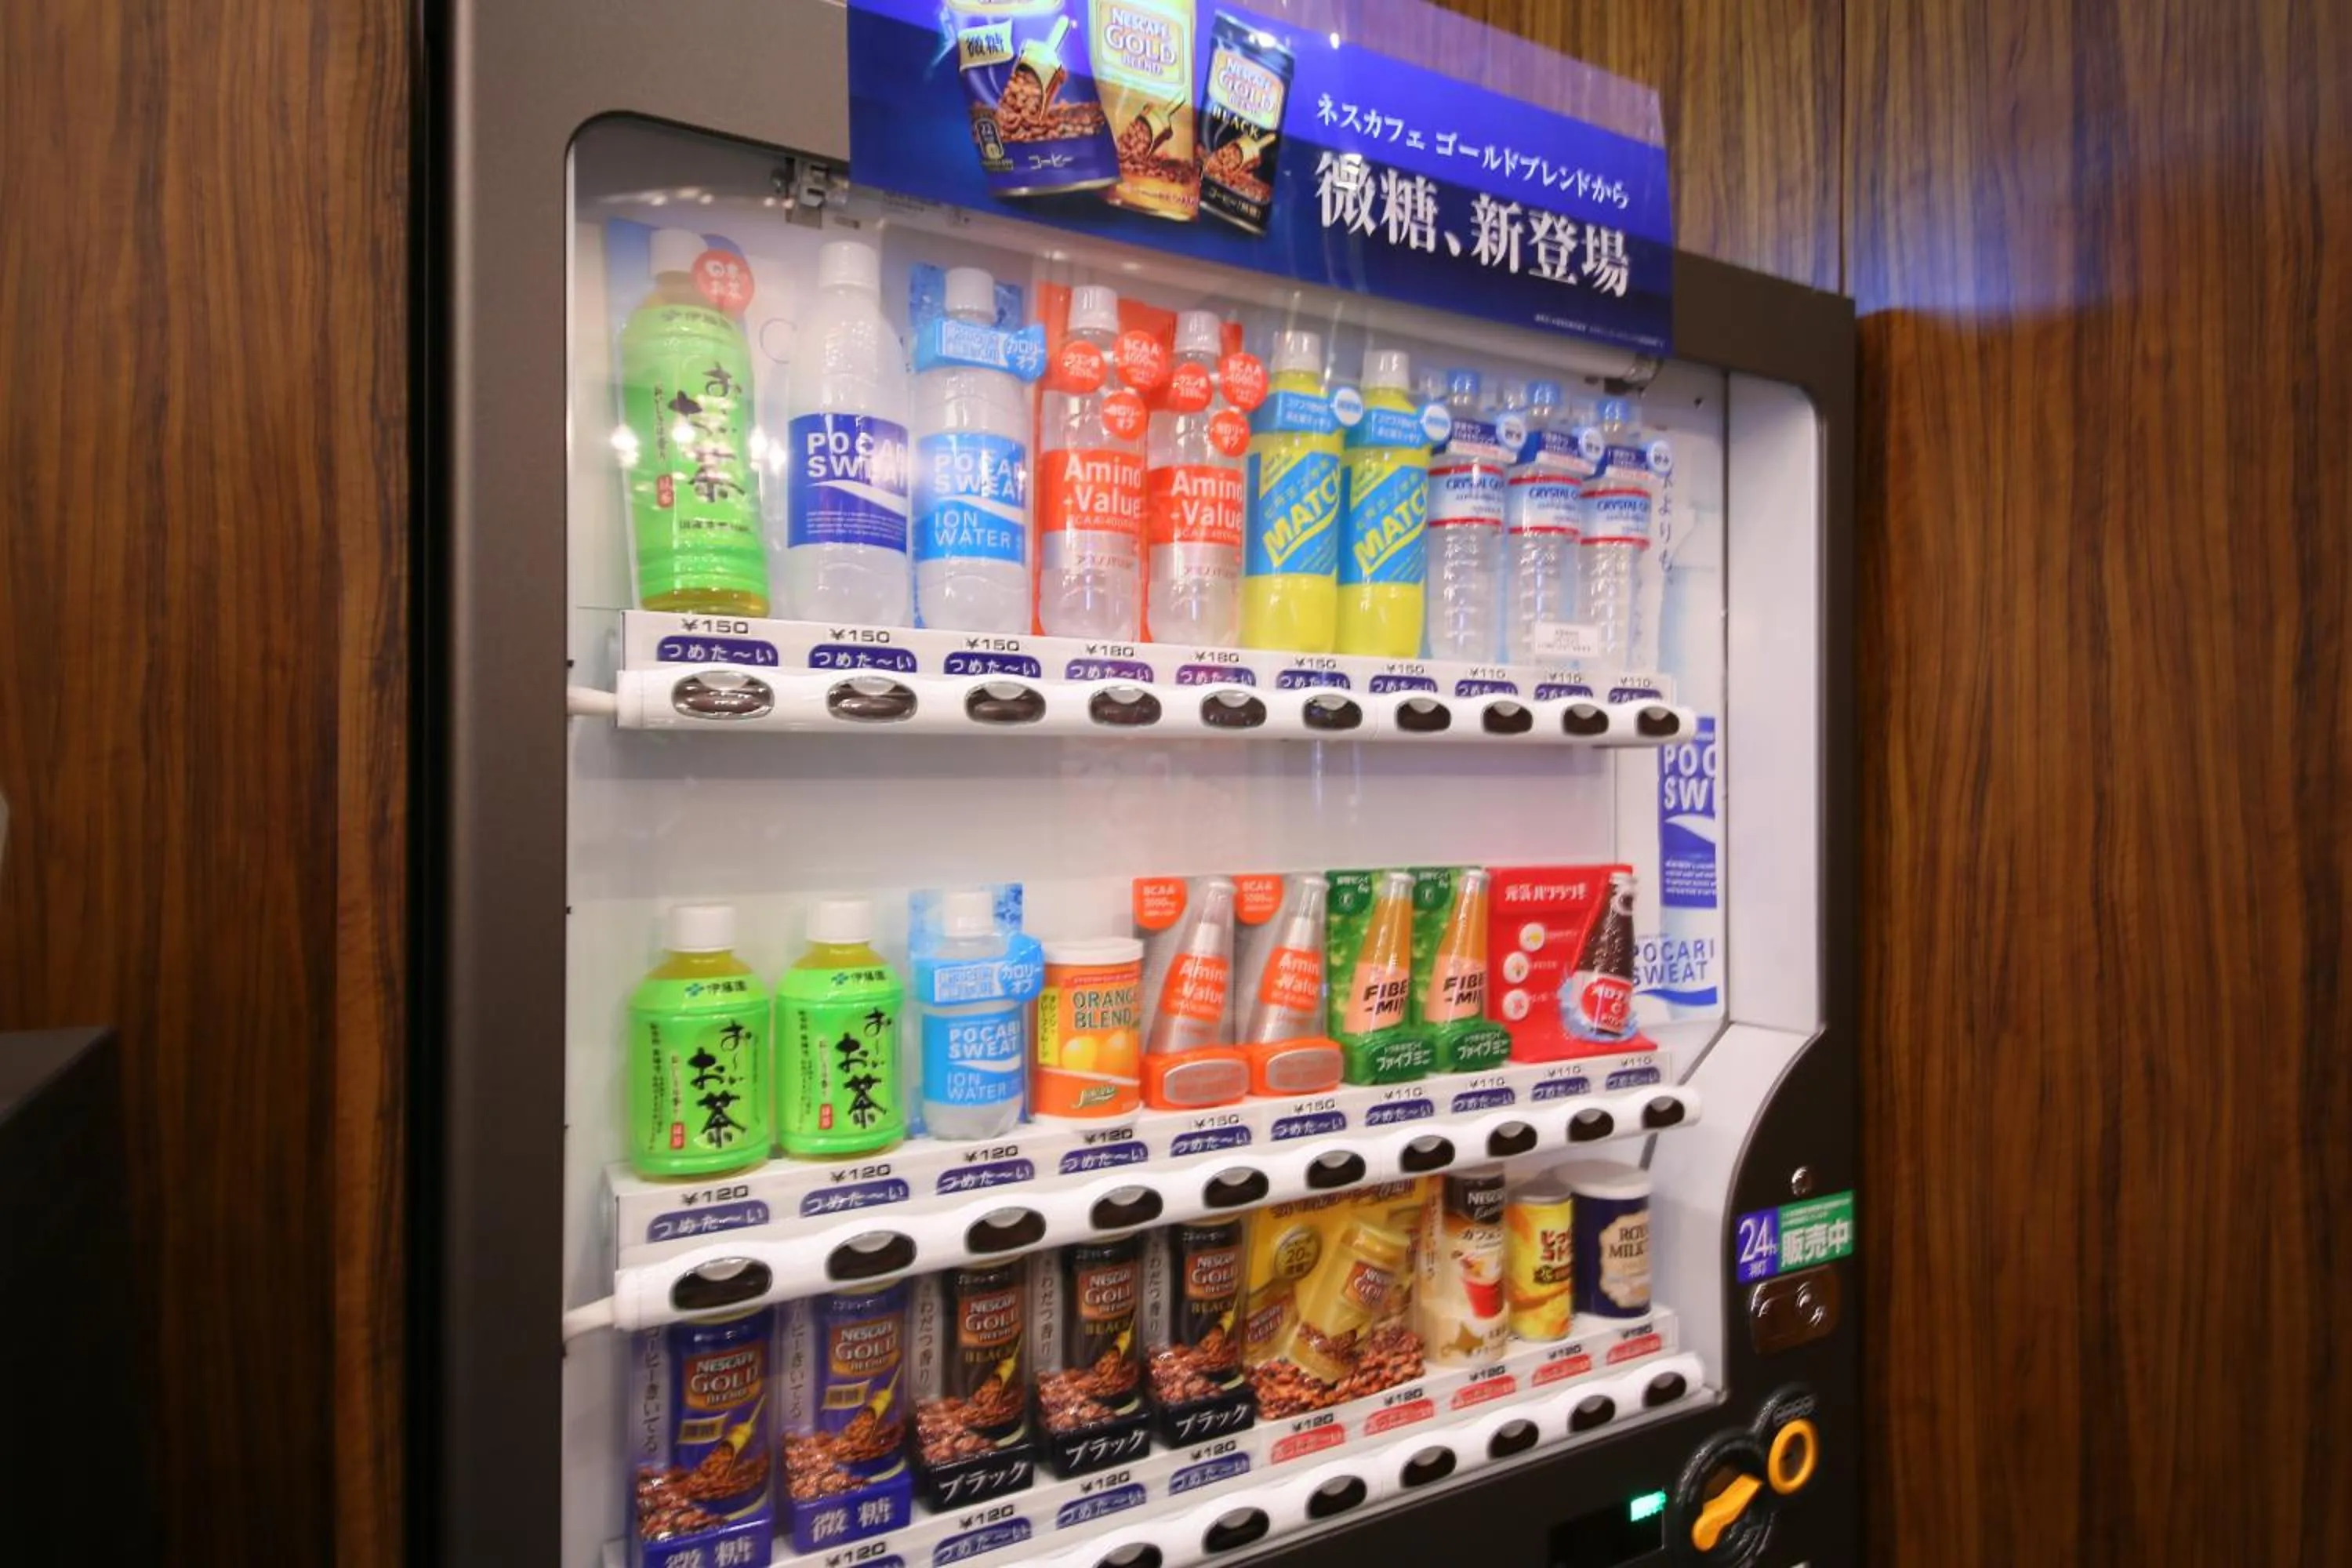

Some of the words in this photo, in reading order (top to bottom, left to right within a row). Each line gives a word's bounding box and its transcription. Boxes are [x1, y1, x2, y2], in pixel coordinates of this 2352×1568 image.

[1105, 24, 1176, 64] GOLD
[1220, 71, 1275, 110] GOLD
[1213, 105, 1259, 138] BLACK
[1317, 93, 1426, 151] ネスカフェ
[1436, 130, 1630, 209] ゴールドブレンドから
[1028, 154, 1073, 169] コーヒー
[1314, 151, 1630, 298] 微糖、新登場
[1530, 486, 1568, 499] CRYSTAL
[1597, 500, 1636, 512] CRYSTAL
[935, 509, 978, 528] ION
[935, 528, 1011, 549] WATER
[681, 618, 749, 635] ¥150
[829, 629, 891, 644] ¥150
[966, 638, 1020, 652] ¥150
[1086, 644, 1134, 659] ¥180
[1195, 651, 1240, 664] ¥180
[1294, 659, 1336, 670] ¥150
[1386, 663, 1425, 675] ¥150
[1470, 668, 1505, 679] ¥110
[1549, 673, 1582, 683] ¥110
[1619, 677, 1650, 688] ¥110
[1002, 964, 1041, 981] カロリー
[1011, 979, 1035, 994] オフ
[1075, 1008, 1132, 1029] BLEND
[949, 1040, 1018, 1059] SWEAT
[1457, 1039, 1510, 1061] ファイブミニ
[1376, 1049, 1432, 1072] ファイブミニ
[1621, 1055, 1652, 1067] ¥110
[948, 1072, 980, 1087] ION
[1548, 1065, 1581, 1078] ¥110
[948, 1083, 1007, 1101] WATER
[1469, 1076, 1505, 1090] ¥110
[1384, 1087, 1422, 1100] ¥110
[1293, 1099, 1336, 1114] ¥150
[1194, 1114, 1240, 1130] ¥150
[1083, 1128, 1133, 1145] ¥120
[964, 1145, 1019, 1163] ¥120
[831, 1163, 891, 1182] ¥120
[681, 1185, 750, 1205] ¥120
[1609, 1243, 1643, 1258] MILK
[1781, 1218, 1849, 1267] 販売中
[836, 1336, 896, 1359] GOLD
[691, 1366, 758, 1393] GOLD
[1470, 1366, 1505, 1381] ¥120
[1385, 1388, 1423, 1406] ¥120
[1176, 1404, 1250, 1439] ブラック
[1292, 1413, 1334, 1432] ¥120
[1066, 1430, 1144, 1468] ブラック
[1191, 1440, 1236, 1461] ¥120
[939, 1461, 1026, 1503] ブラック
[1080, 1471, 1132, 1493] ¥120
[811, 1497, 893, 1543] 微糖
[960, 1504, 1015, 1530] ¥120
[826, 1541, 885, 1564] ¥120
